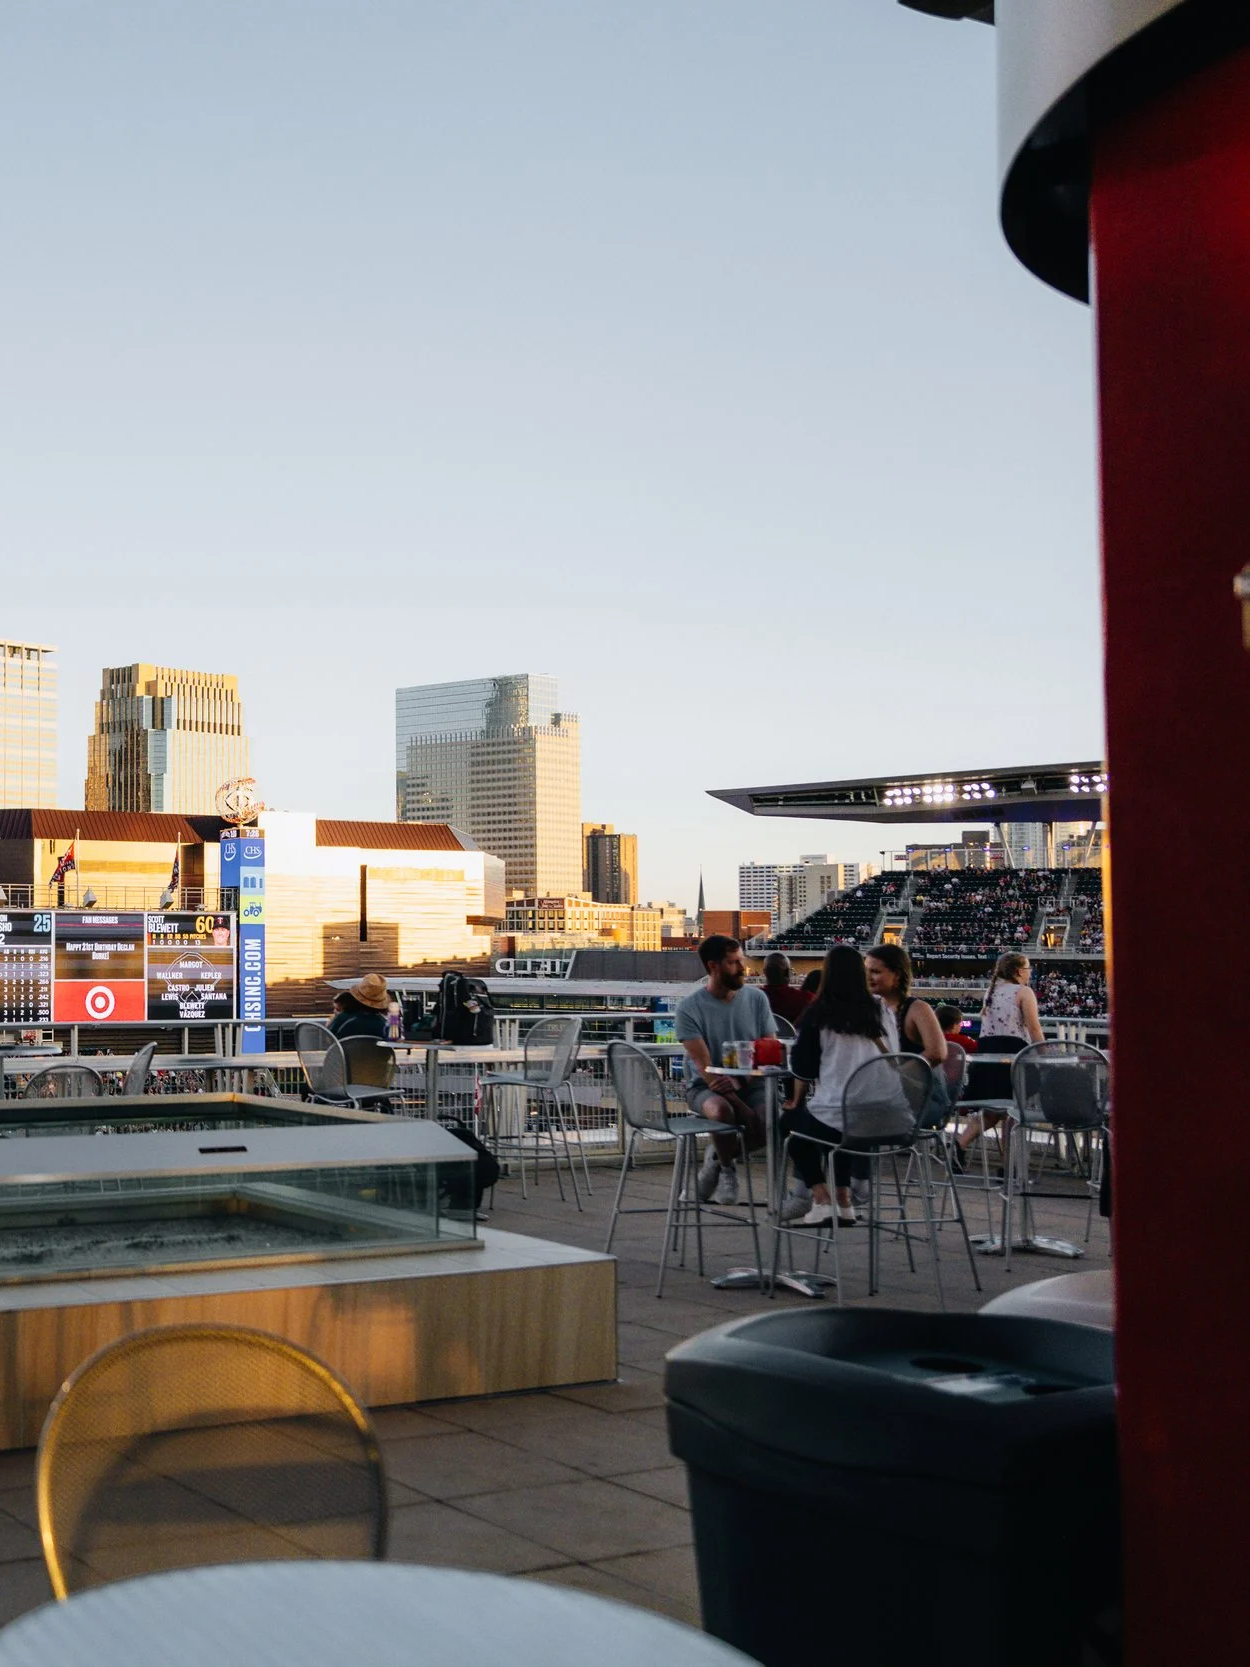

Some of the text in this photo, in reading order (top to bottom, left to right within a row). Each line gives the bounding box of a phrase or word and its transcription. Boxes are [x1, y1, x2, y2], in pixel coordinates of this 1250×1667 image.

[33, 914, 51, 932] 25
[82, 916, 118, 924] FAN MESSAGES
[195, 916, 214, 933] 60
[148, 923, 179, 933] BLEWETT
[179, 961, 203, 969] MARGOT
[244, 939, 261, 1032] CHSINC.COM
[161, 993, 179, 1001] LEWIS
[179, 1002, 205, 1010] BLEWETT
[179, 1009, 205, 1018] VÁZQUEZ
